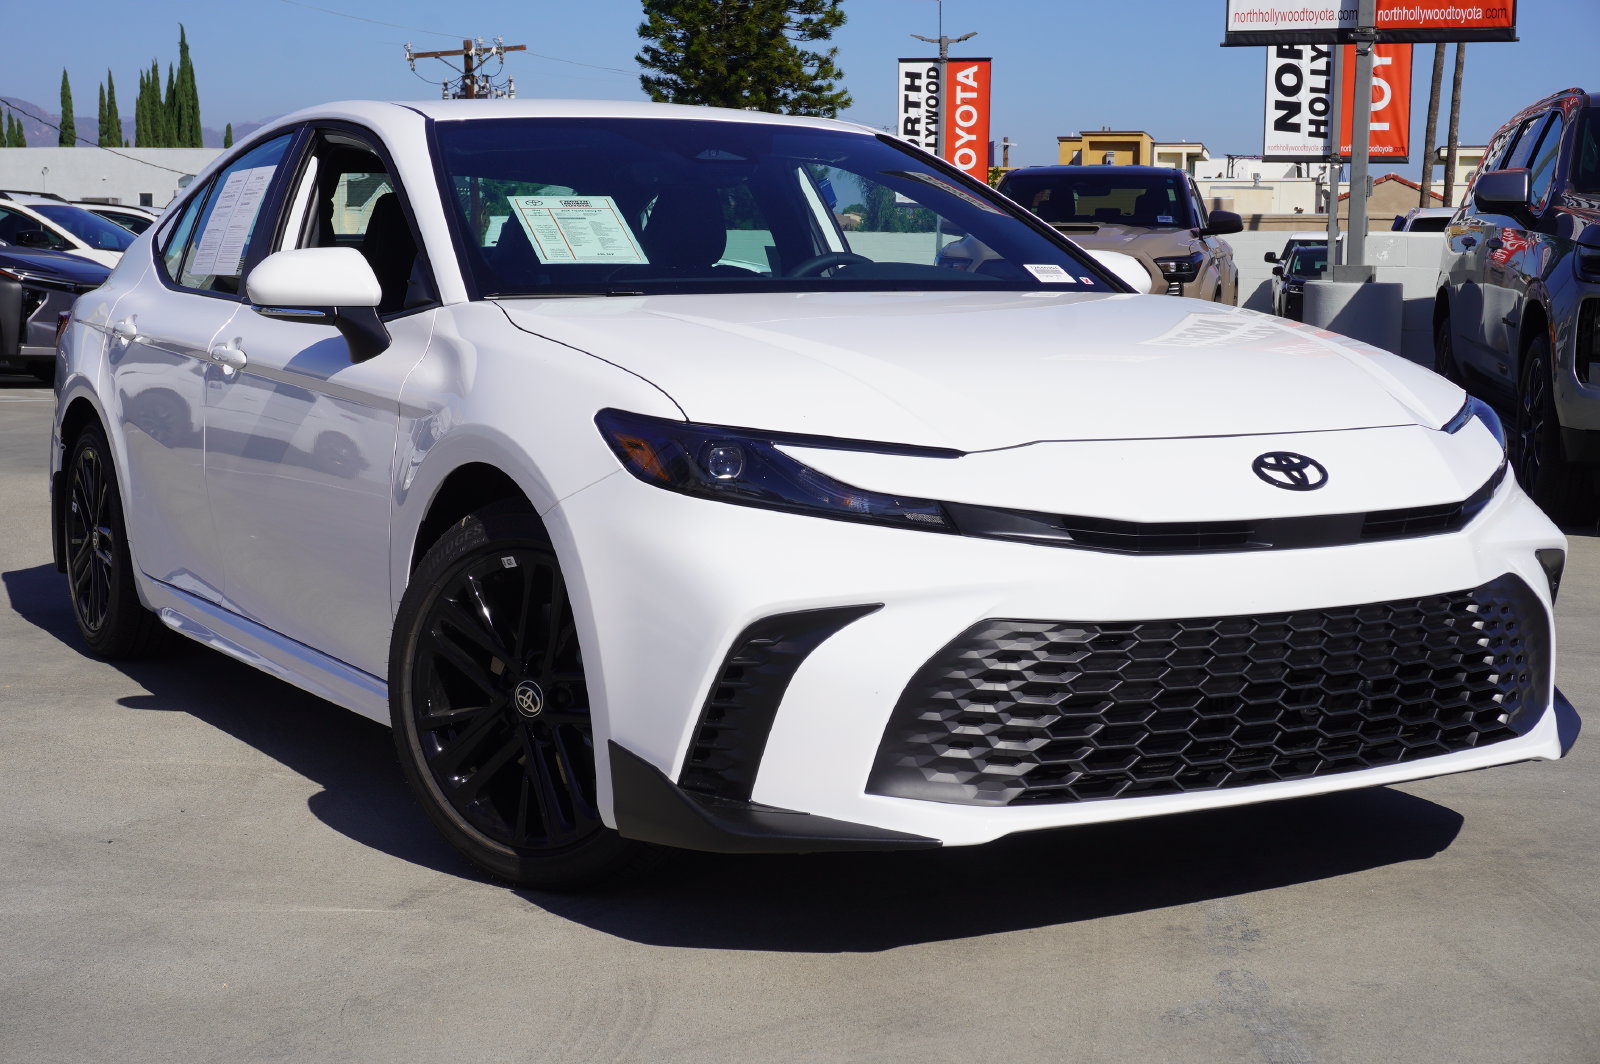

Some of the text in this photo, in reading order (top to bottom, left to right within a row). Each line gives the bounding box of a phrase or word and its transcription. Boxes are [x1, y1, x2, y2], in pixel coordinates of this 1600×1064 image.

[1233, 8, 1358, 25] northhollywoodtoyota.com
[1377, 5, 1507, 24] northhollywoodtoyota.com
[925, 66, 940, 155] LYWOOD
